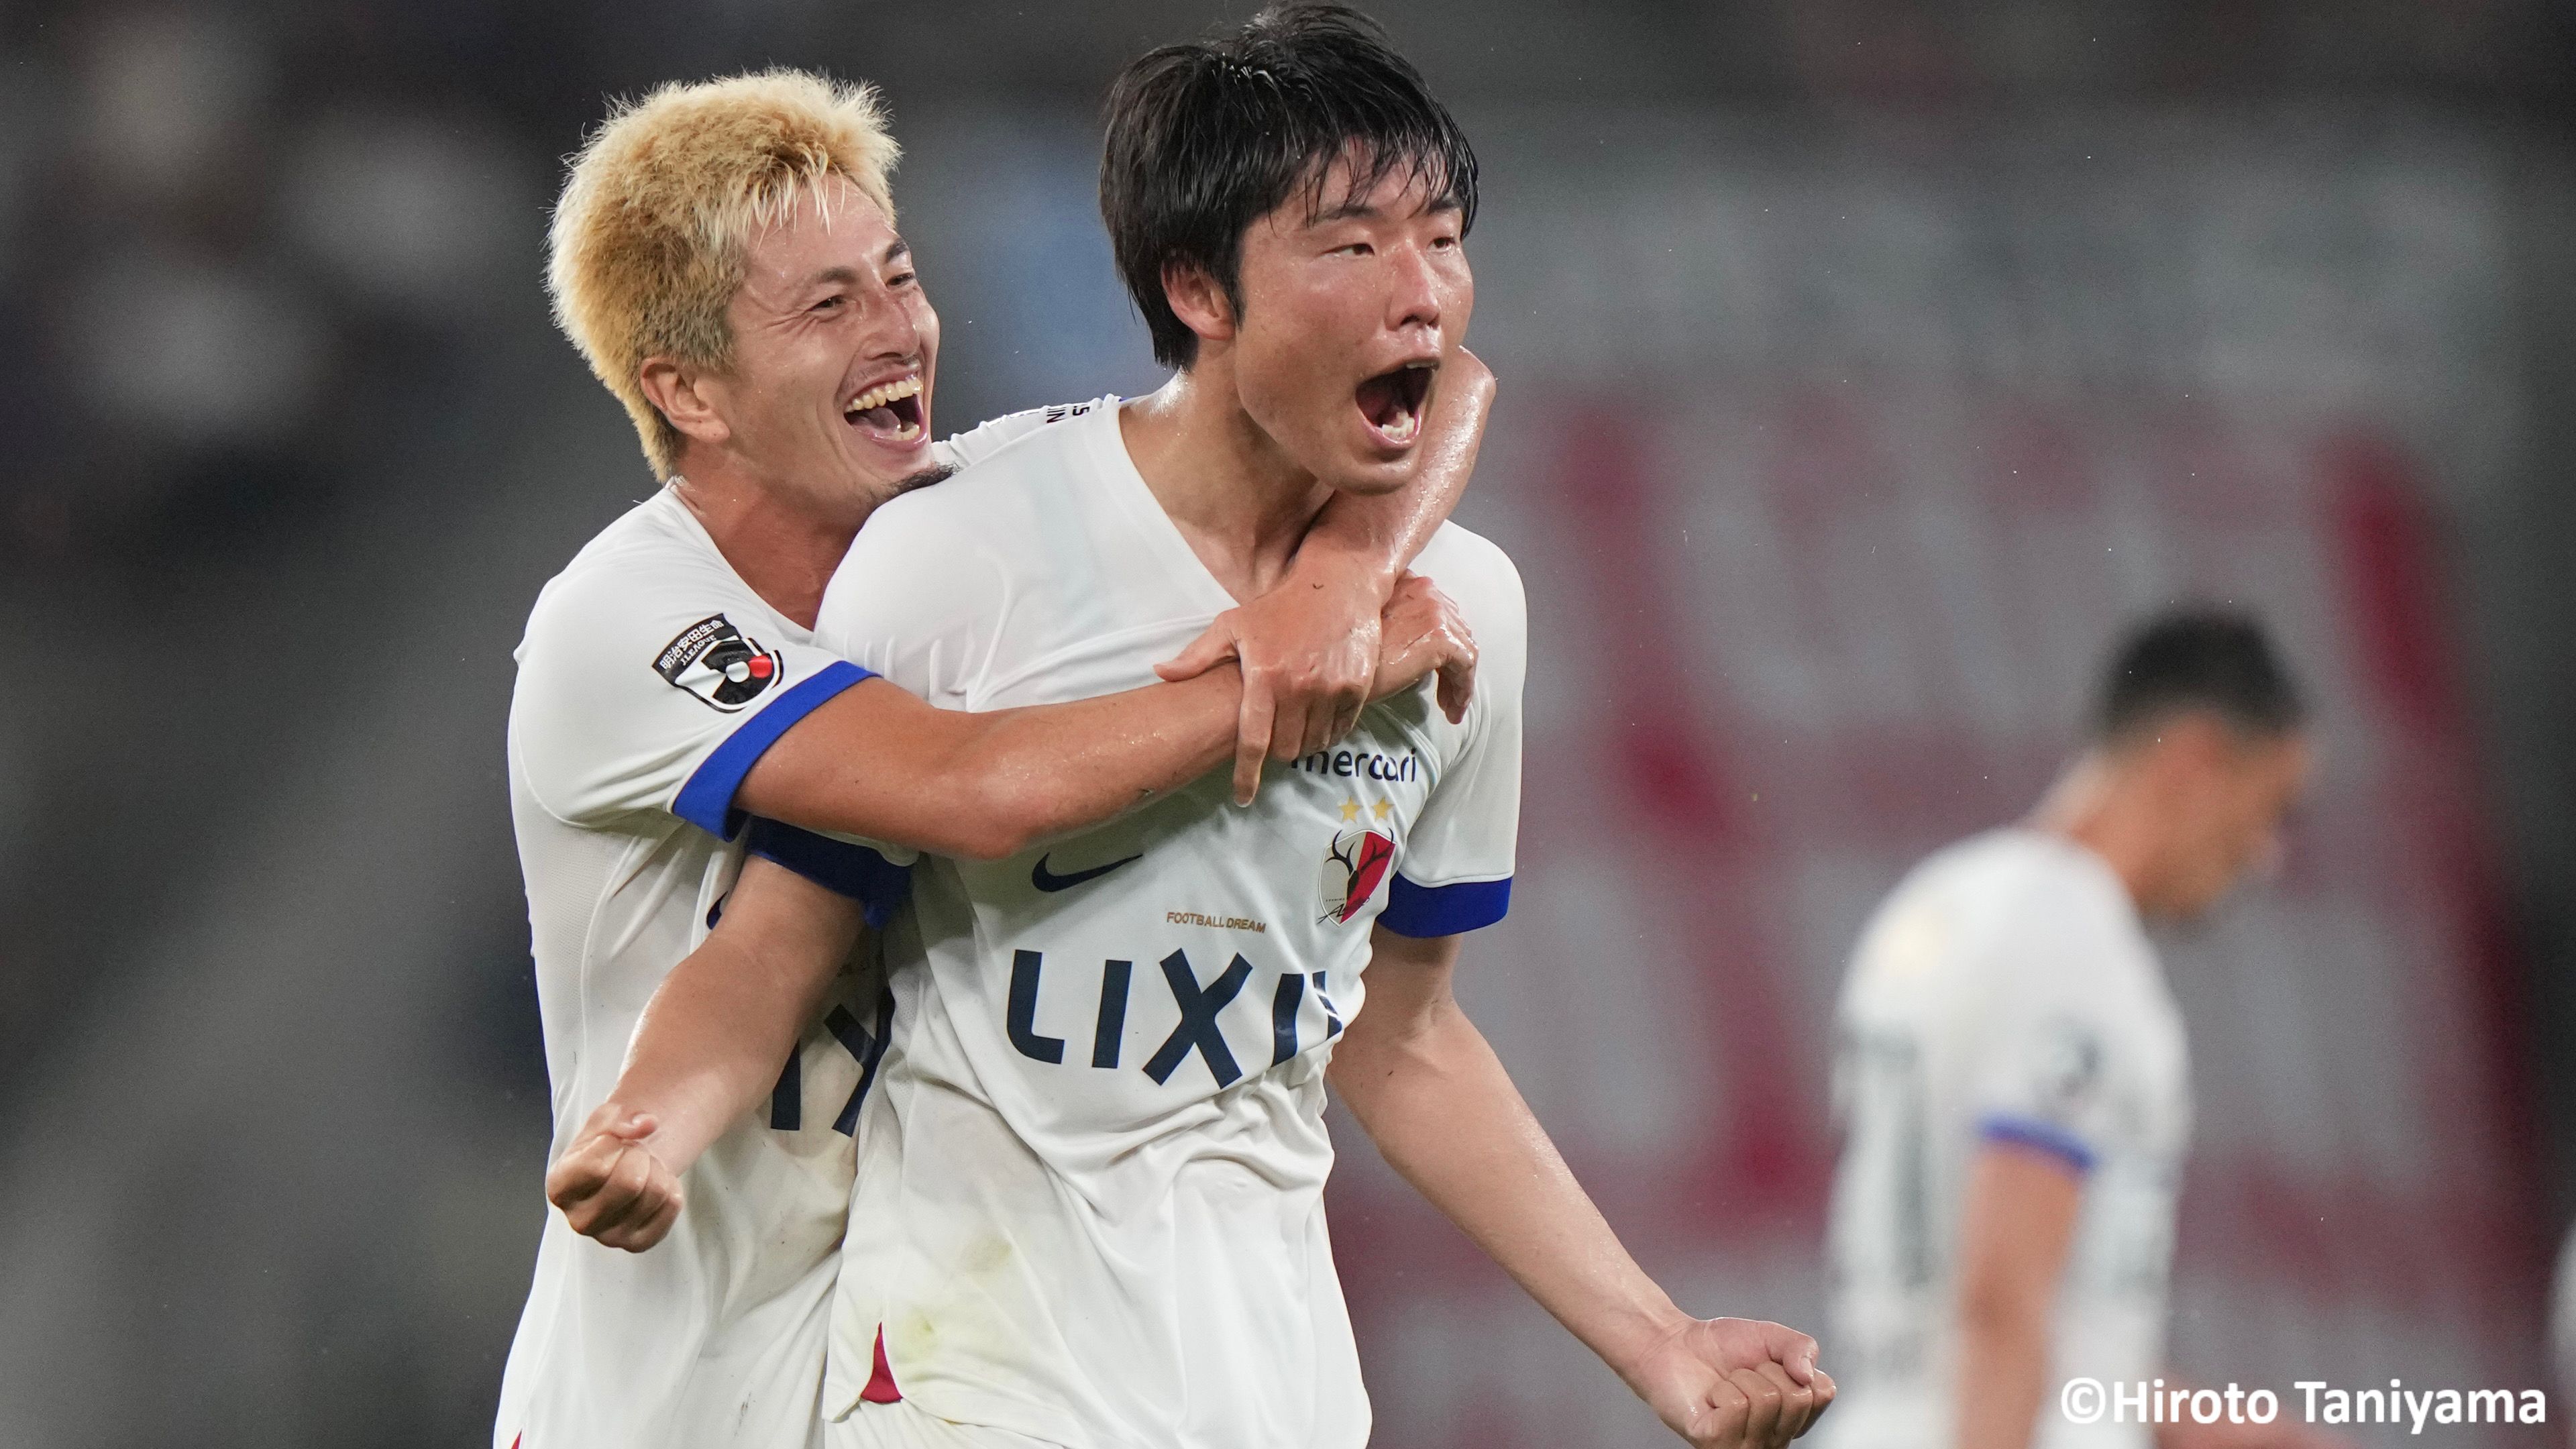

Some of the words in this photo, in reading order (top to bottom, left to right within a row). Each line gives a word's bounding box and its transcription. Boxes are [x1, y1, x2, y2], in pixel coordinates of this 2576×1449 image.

[659, 619, 724, 669] 明治安田生命
[1167, 912, 1224, 928] FOOTBALL
[1226, 918, 1267, 934] DREAM
